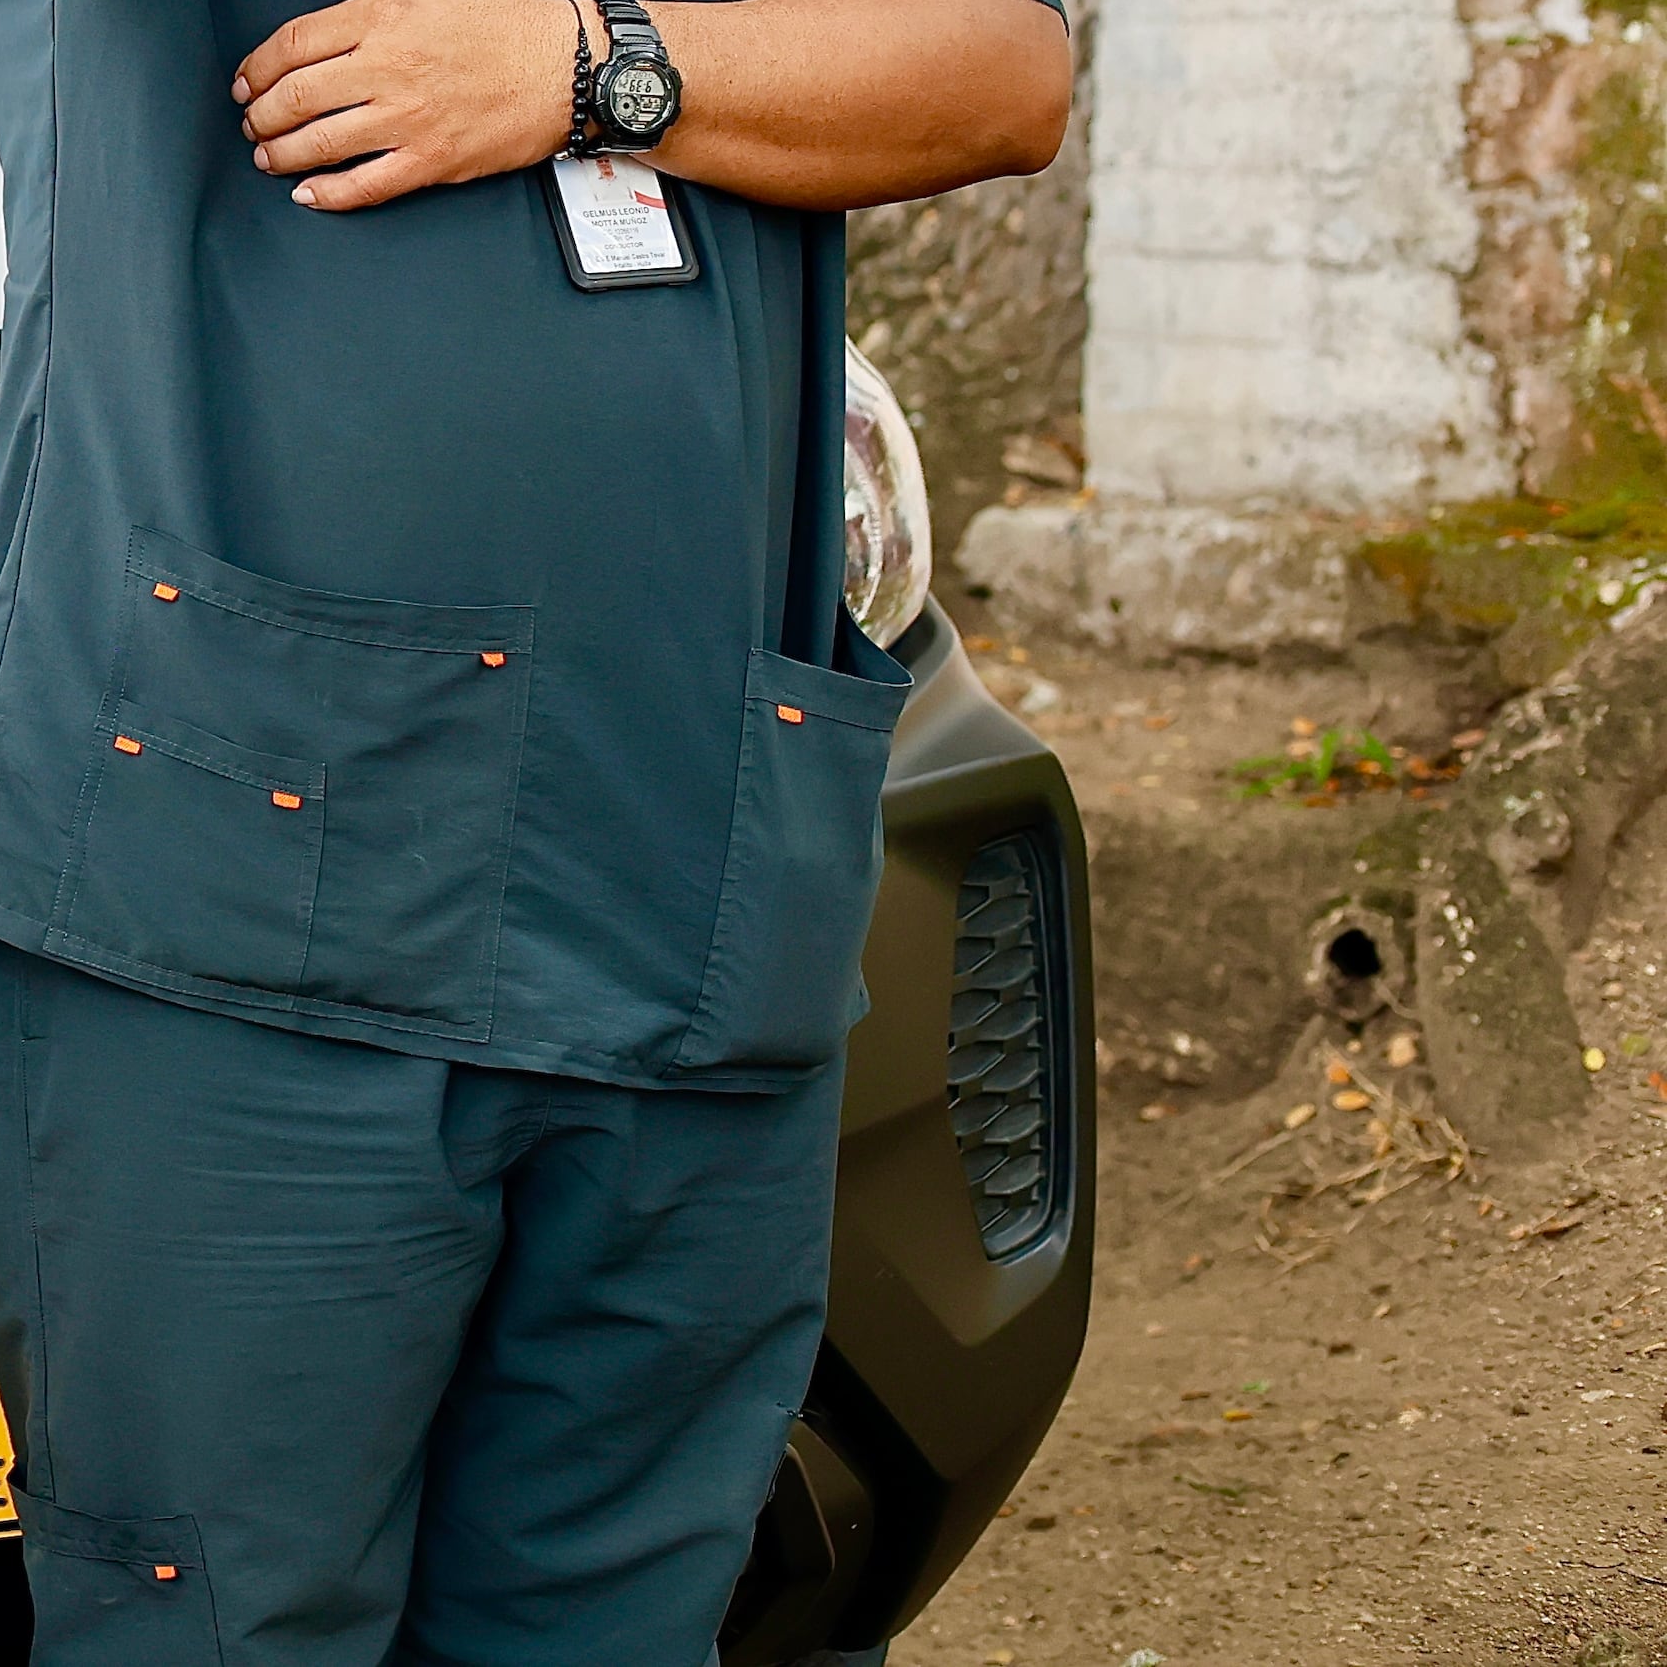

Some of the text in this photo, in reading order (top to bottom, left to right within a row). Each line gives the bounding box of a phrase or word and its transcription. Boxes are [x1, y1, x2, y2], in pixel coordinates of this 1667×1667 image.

[583, 206, 649, 218] GELMUS LEONID
[591, 219, 619, 227] MOTTA
